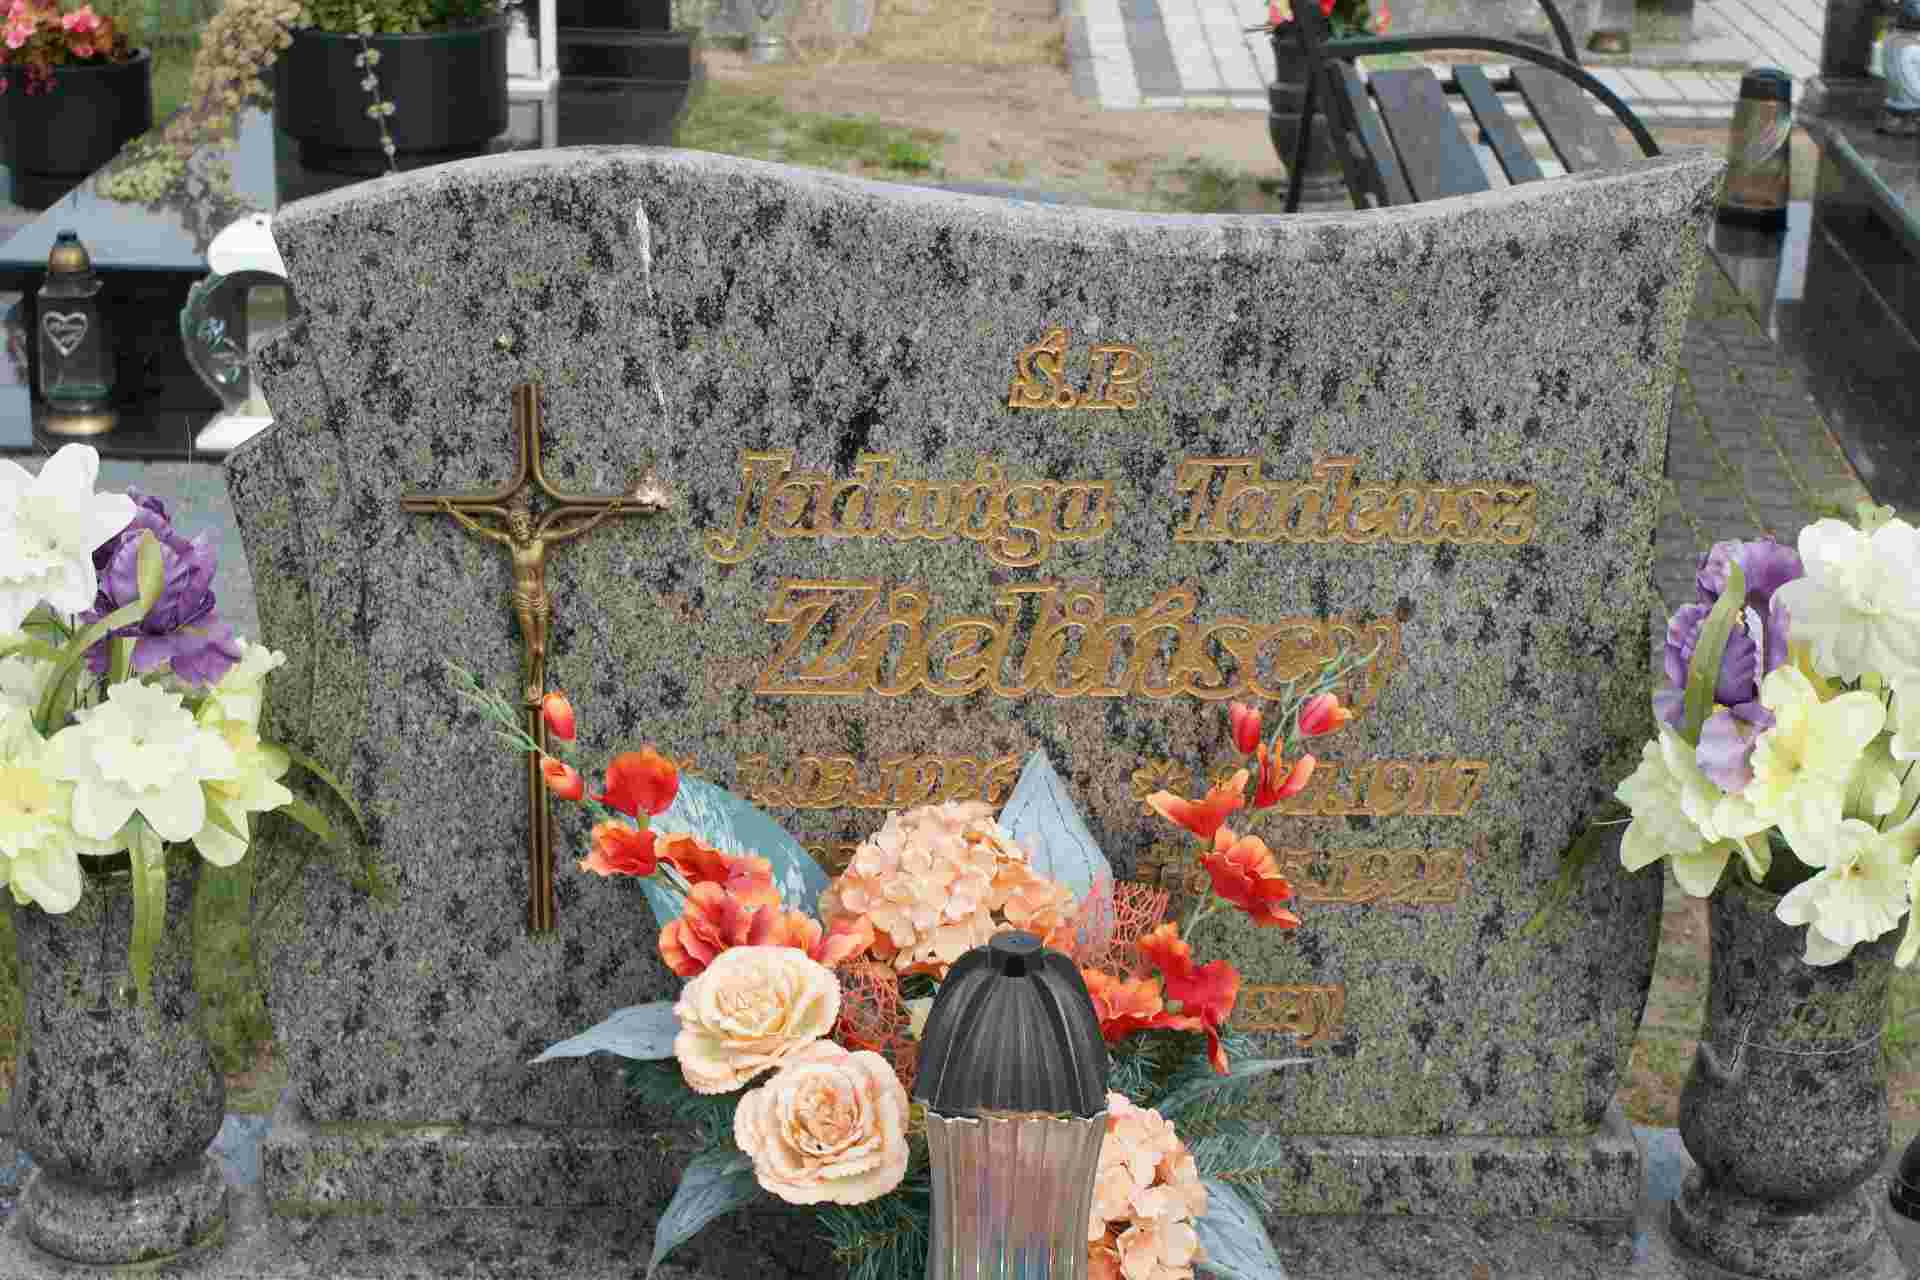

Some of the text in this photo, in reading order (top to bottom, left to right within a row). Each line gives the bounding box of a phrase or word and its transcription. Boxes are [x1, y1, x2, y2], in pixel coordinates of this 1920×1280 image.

[704, 447, 1538, 569] Jadwiga Tadeusz
[753, 576, 1400, 712] Zielińscy
